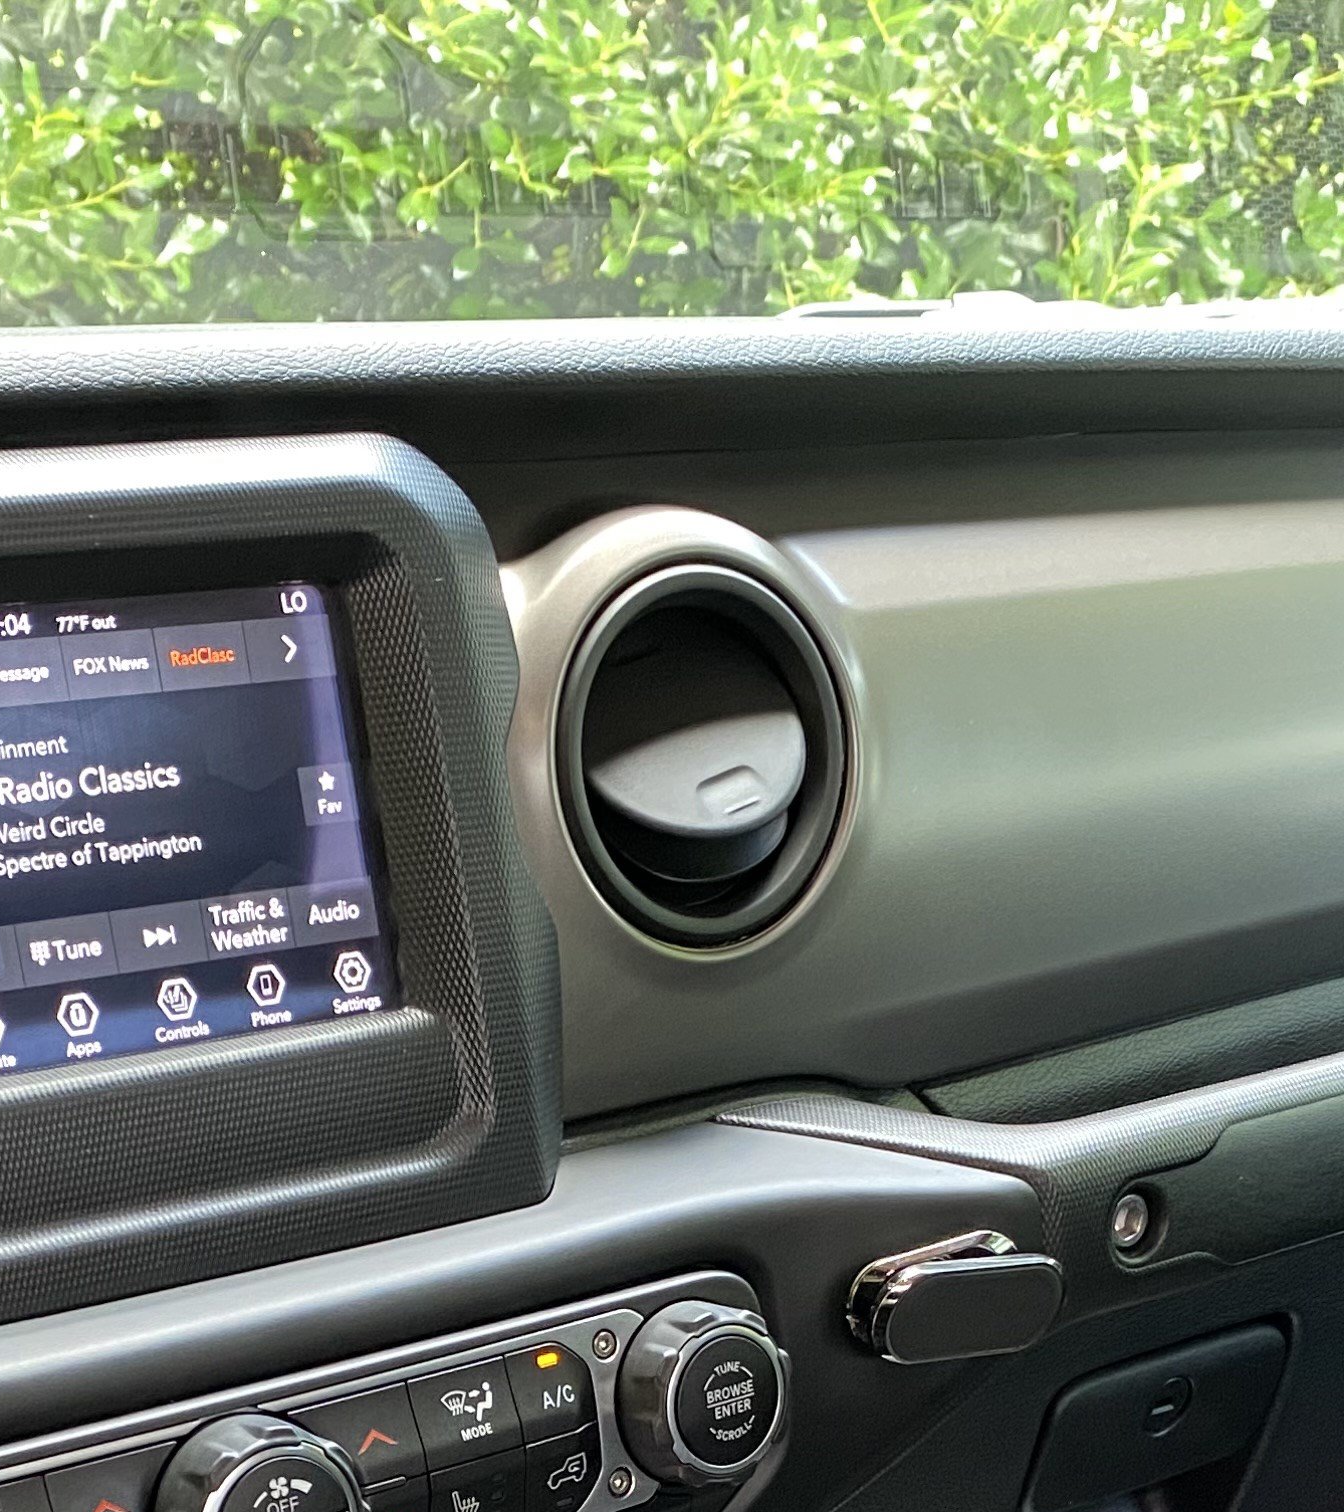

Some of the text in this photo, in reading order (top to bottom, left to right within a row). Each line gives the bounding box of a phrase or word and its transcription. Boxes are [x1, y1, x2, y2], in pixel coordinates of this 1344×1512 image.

[280, 591, 308, 614] LO
[92, 614, 118, 631] out
[73, 655, 150, 676] FOX News
[170, 646, 235, 668] RadClasc
[79, 762, 181, 796] Classics
[317, 798, 343, 815] Fav
[50, 812, 105, 838] Circle
[71, 842, 92, 866] of
[94, 834, 202, 865] Tappington
[208, 898, 285, 927] Traffic &
[308, 900, 361, 926] Audio
[211, 924, 288, 952] Weather
[53, 938, 103, 961] Tune
[333, 994, 382, 1015] Settings
[251, 1009, 292, 1028] Phone
[155, 1021, 210, 1043] Controls
[66, 1040, 102, 1059] Apps
[714, 1361, 741, 1376] TUNE
[543, 1384, 576, 1410] A/C
[706, 1379, 754, 1404] BROWSE
[714, 1398, 752, 1420] ENTER
[460, 1422, 493, 1441] MODE
[716, 1422, 752, 1441] SCROLL
